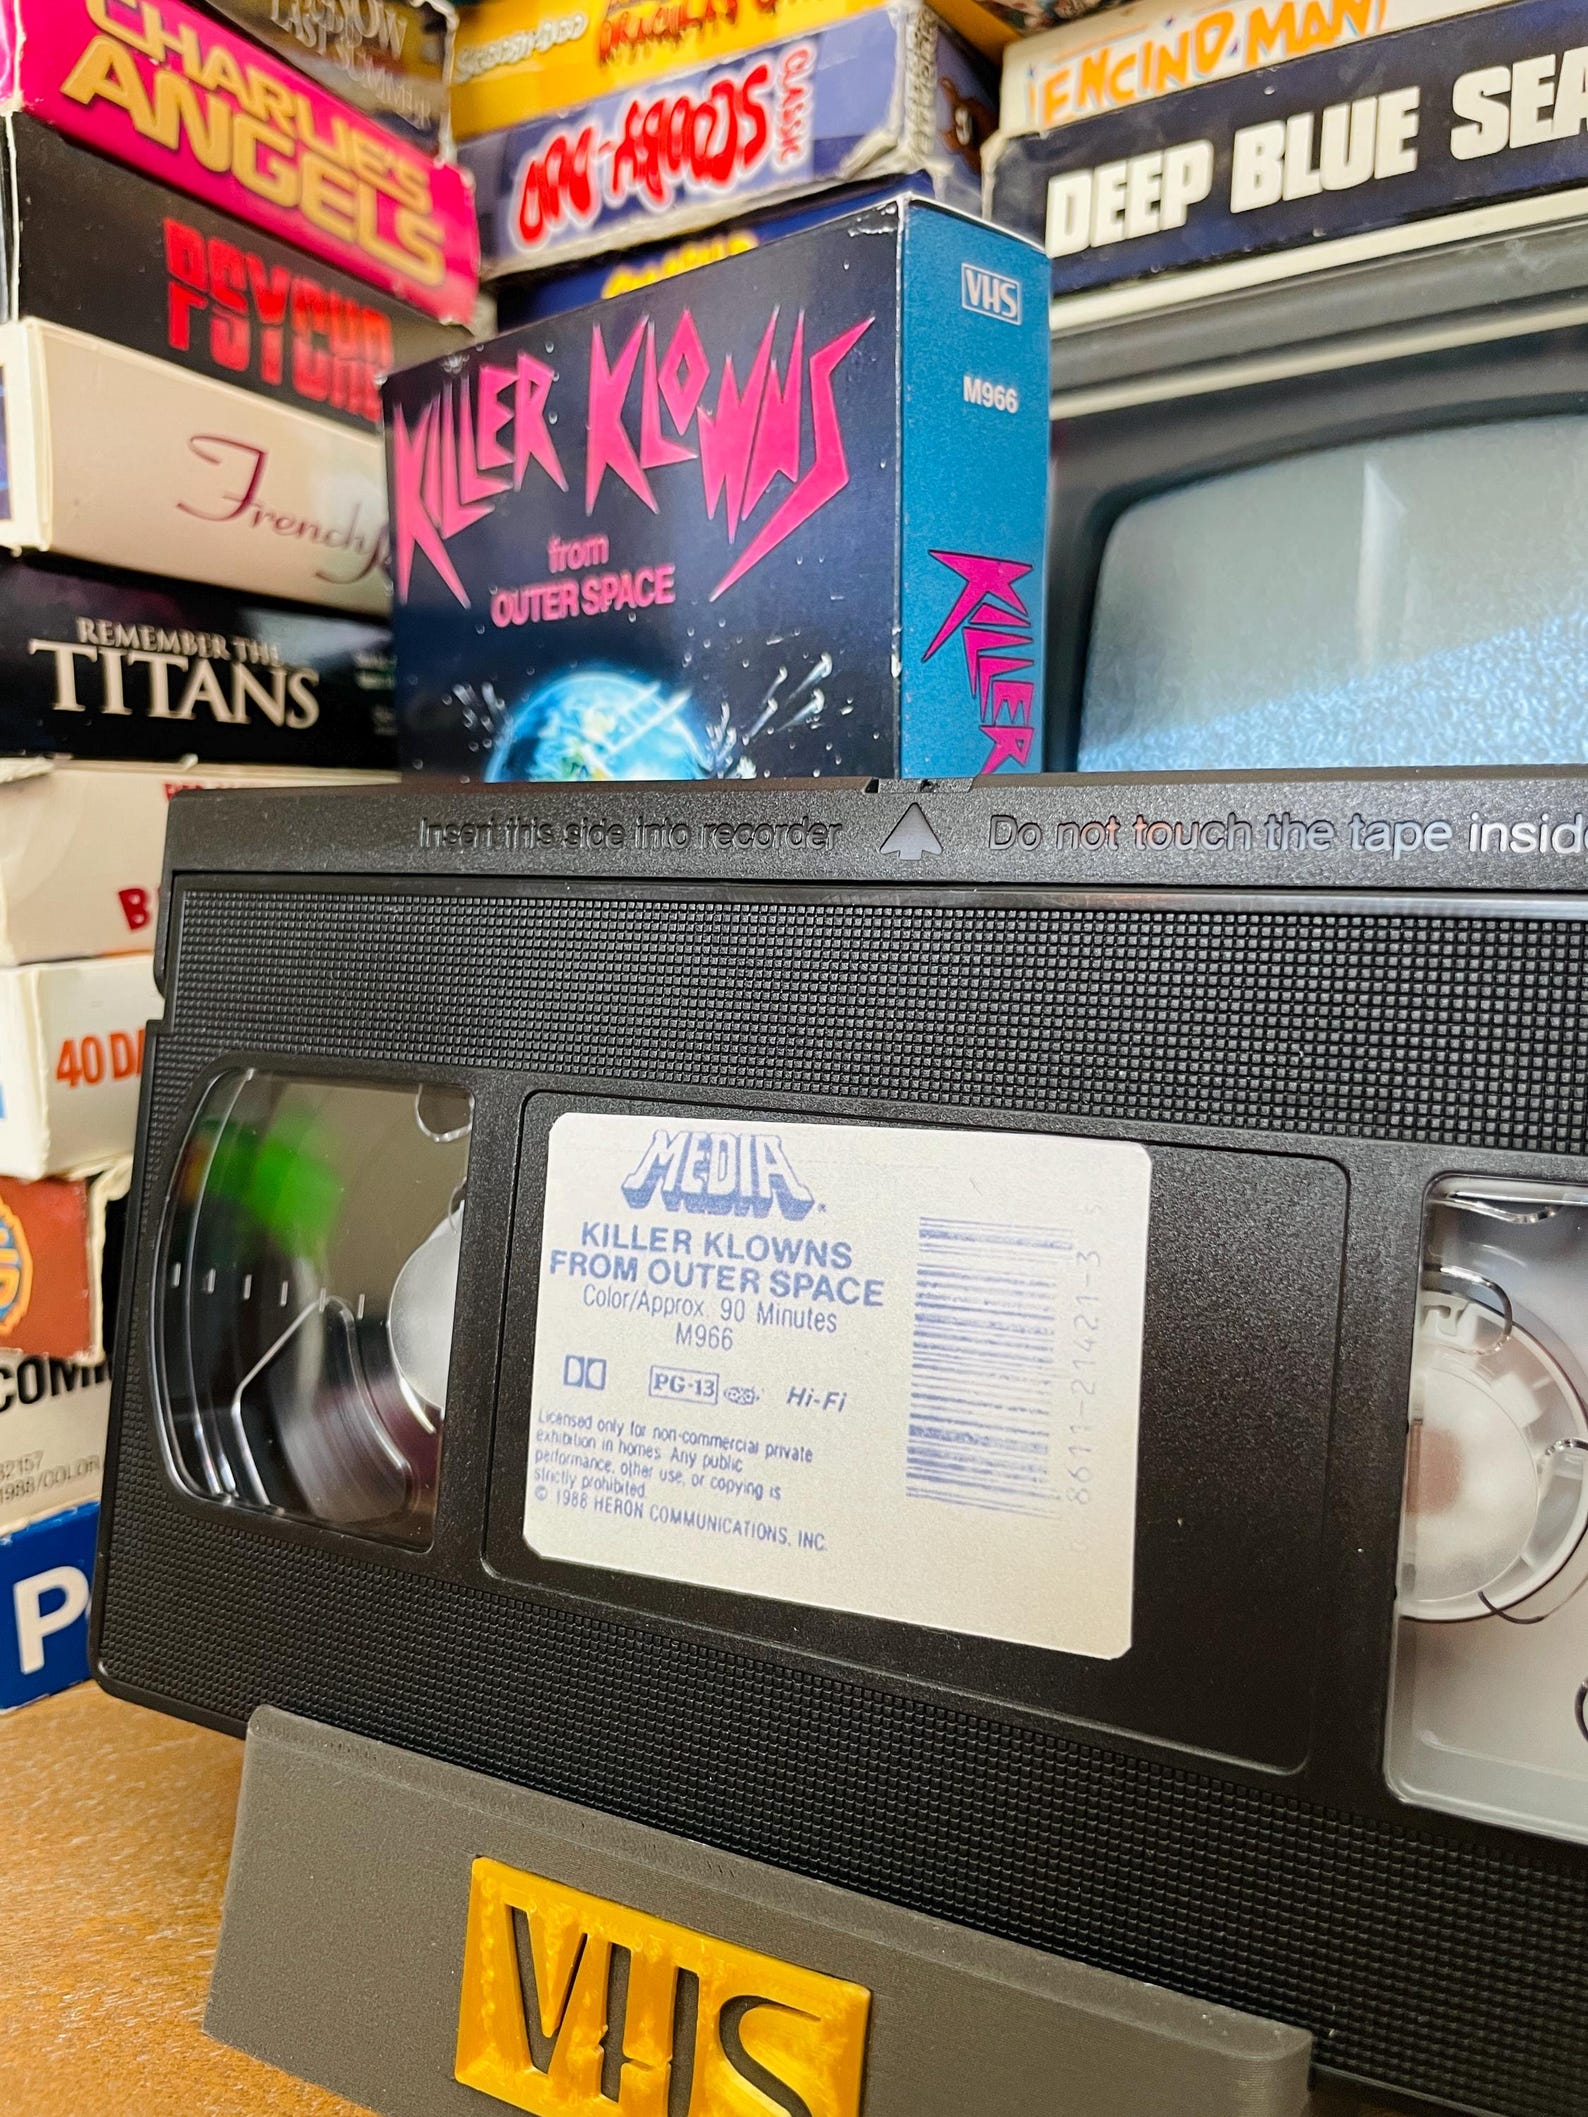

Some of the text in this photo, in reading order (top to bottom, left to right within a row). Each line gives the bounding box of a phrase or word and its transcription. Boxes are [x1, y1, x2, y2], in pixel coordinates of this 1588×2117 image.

[1043, 10, 1235, 127] ENCINO
[1243, 0, 1376, 69] MAN
[60, 35, 446, 288] ANGELS
[1046, 46, 1588, 259] DEEP BLUE SEA
[965, 268, 1018, 319] VHS
[963, 375, 1019, 414] M966
[394, 304, 876, 609] KILLER KLOWNS
[548, 534, 610, 575] from
[491, 563, 677, 629] OUTER SPACE
[75, 615, 284, 668] REMEMBER THE
[922, 549, 1035, 775] KILLER
[28, 637, 321, 731] TITANS
[419, 815, 843, 851] Insert this side into recorder
[988, 811, 1588, 861] Do not touch the tape insid
[55, 1035, 105, 1089] 40
[621, 1128, 815, 1222] MEDIA
[581, 1220, 853, 1270] KILLER KLOWNS
[550, 1249, 886, 1308] FROM OUTER SPACE
[674, 1321, 734, 1351] M966
[719, 1297, 746, 1323] 90
[756, 1305, 838, 1334] Minutes
[652, 1371, 716, 1398] PG-13
[786, 1385, 848, 1414] Hi-Fi
[536, 1428, 597, 1449] exhibition
[601, 1438, 614, 1453] in
[670, 1446, 697, 1468] Any
[702, 1452, 743, 1473] public
[538, 1409, 813, 1463] Licensed only for non-commercial private
[534, 1466, 577, 1489] strictly
[620, 1460, 654, 1478] other
[691, 1473, 705, 1488] or
[710, 1475, 764, 1501] copying
[769, 1485, 782, 1501] is
[594, 1495, 645, 1520] HERON
[505, 1902, 823, 2117] VHS
